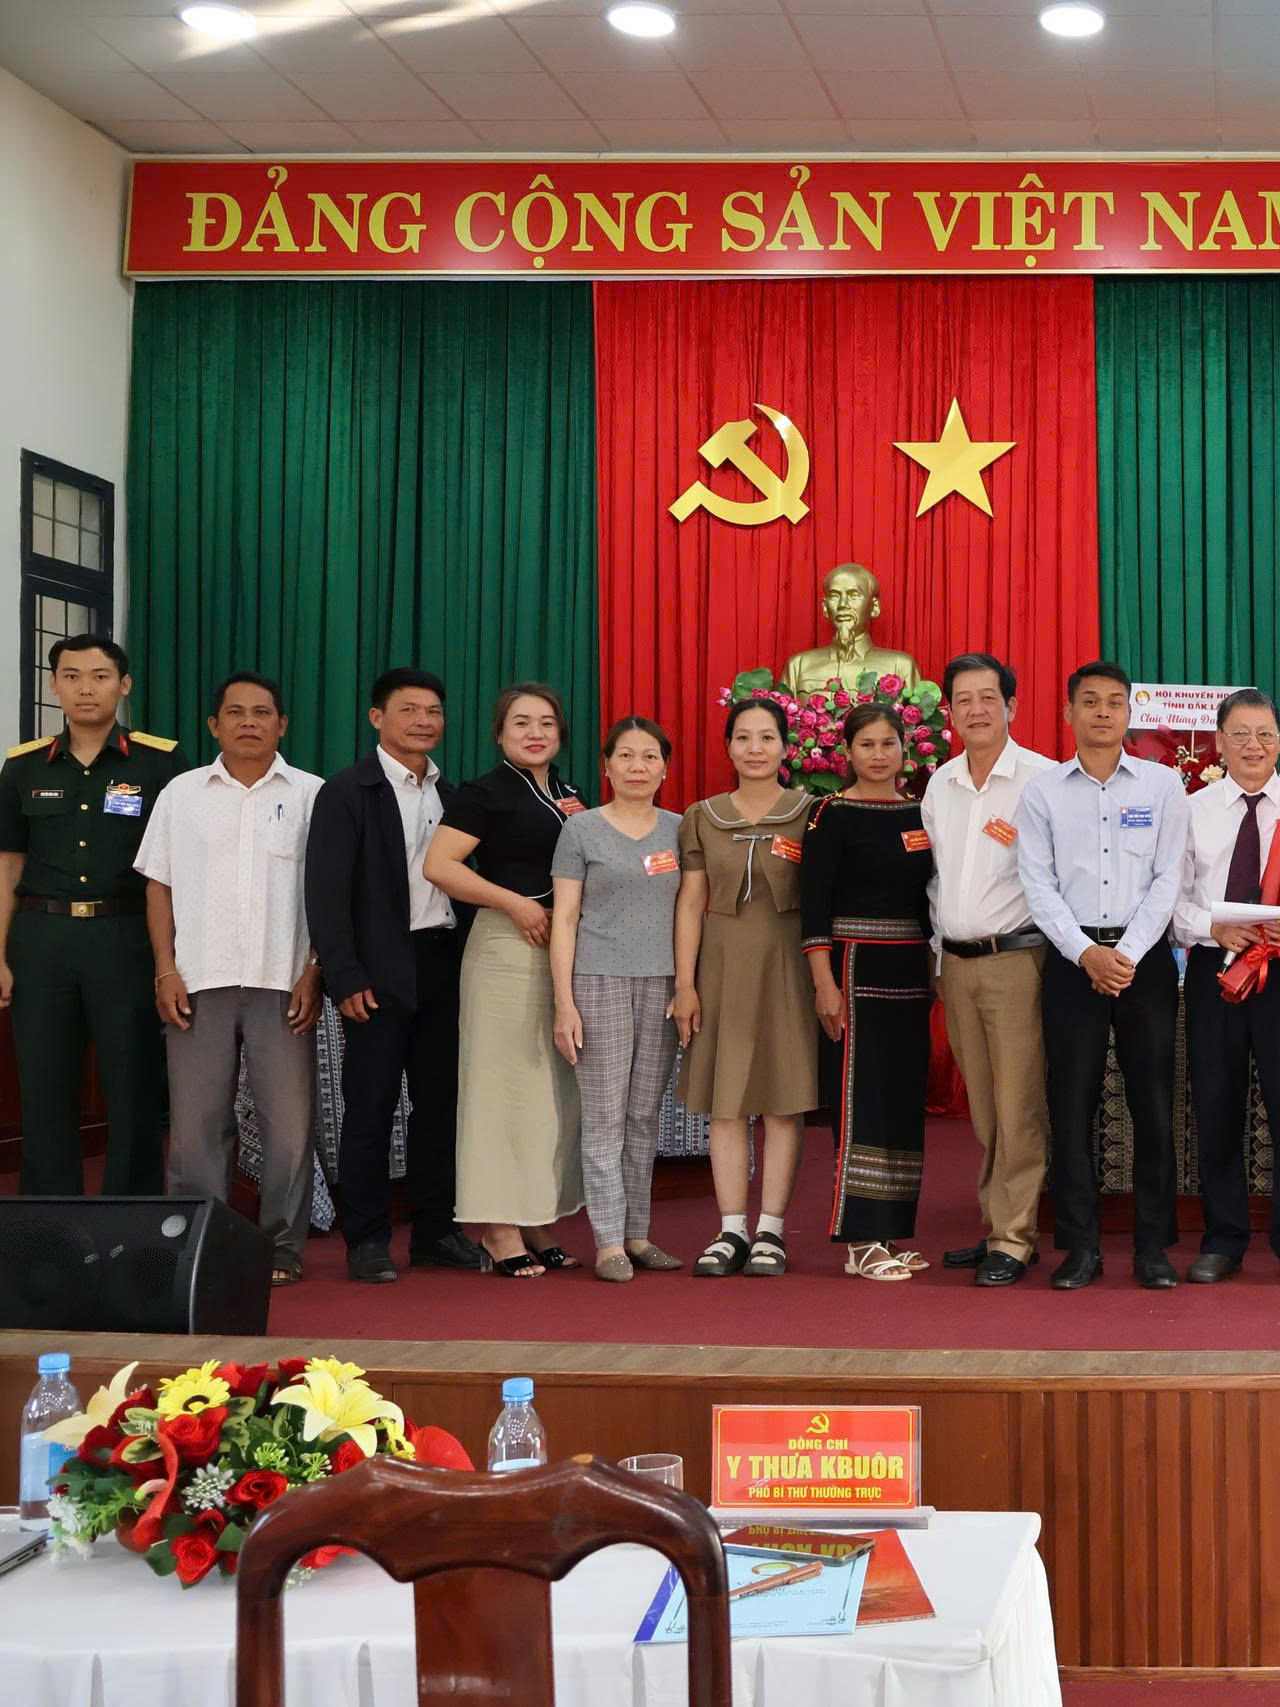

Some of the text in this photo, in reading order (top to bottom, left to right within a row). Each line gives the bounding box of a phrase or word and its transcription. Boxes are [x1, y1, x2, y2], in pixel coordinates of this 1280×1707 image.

[182, 165, 427, 253] ĐẢNG
[454, 174, 694, 268] CỘNG
[721, 164, 891, 252] SẢN
[913, 173, 1115, 267] VIỆT
[727, 1452, 904, 1479] Y THƯA KBUÔR
[749, 1485, 770, 1498] PHÓ
[773, 1485, 784, 1498] BÍ
[787, 1486, 808, 1498] THƯ
[855, 1486, 882, 1500] TRỰC
